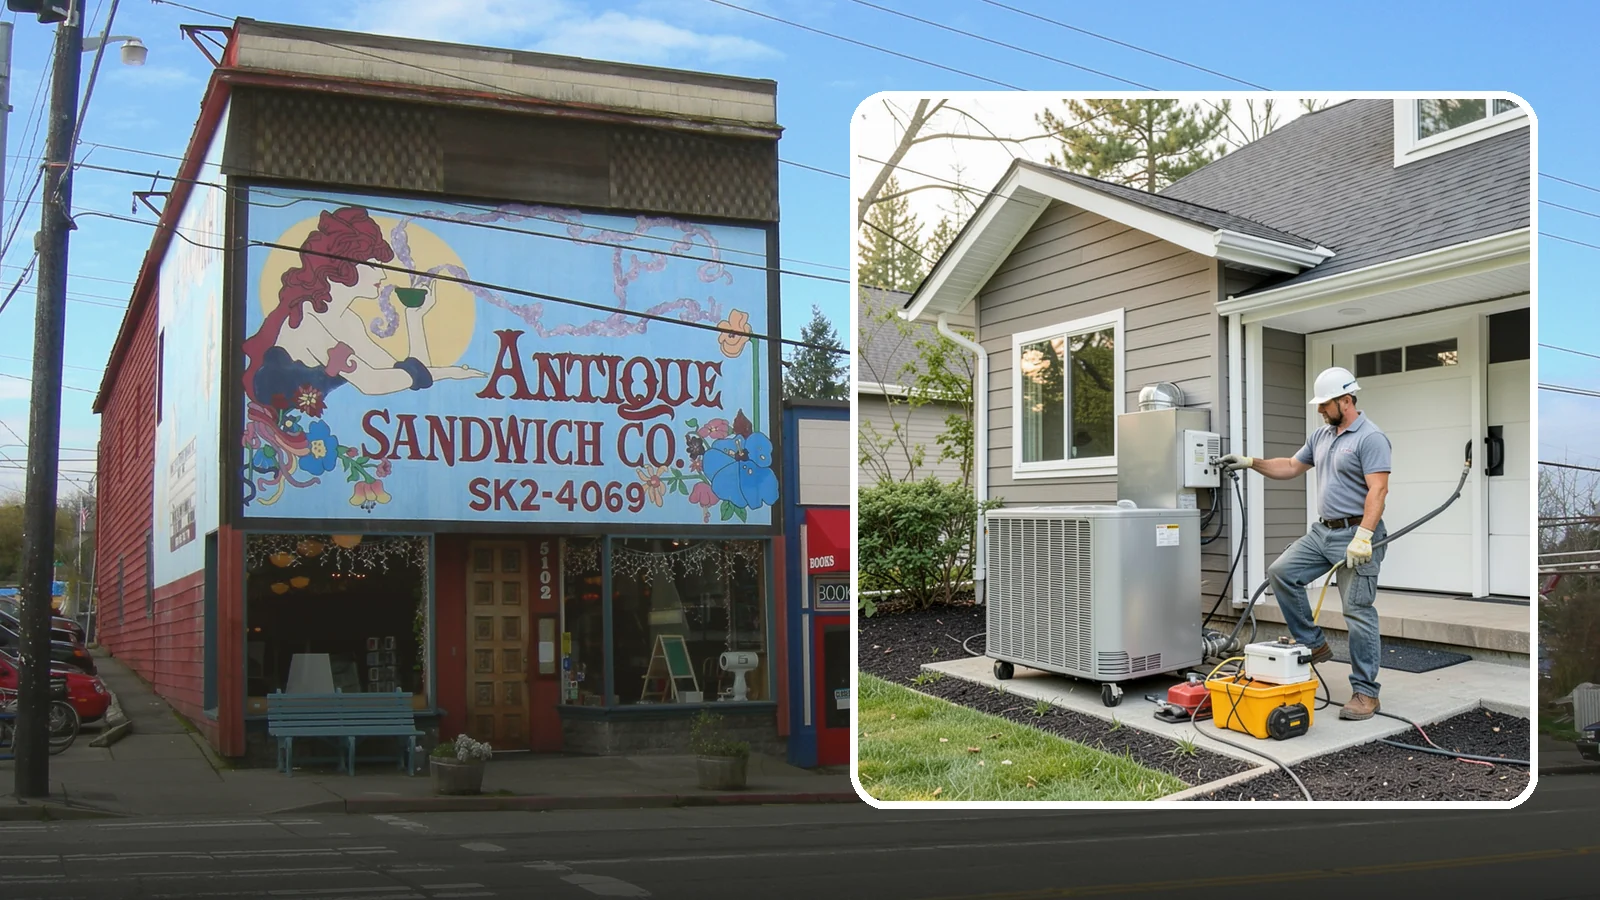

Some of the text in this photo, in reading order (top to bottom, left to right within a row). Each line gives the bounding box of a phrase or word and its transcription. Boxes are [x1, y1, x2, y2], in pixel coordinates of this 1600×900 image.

[476, 329, 723, 420] ANTIQUE
[361, 408, 684, 468] SANDWICH CO.
[468, 476, 645, 513] SK2-4069
[539, 541, 551, 600] 5102
[809, 555, 834, 568] BOOKS
